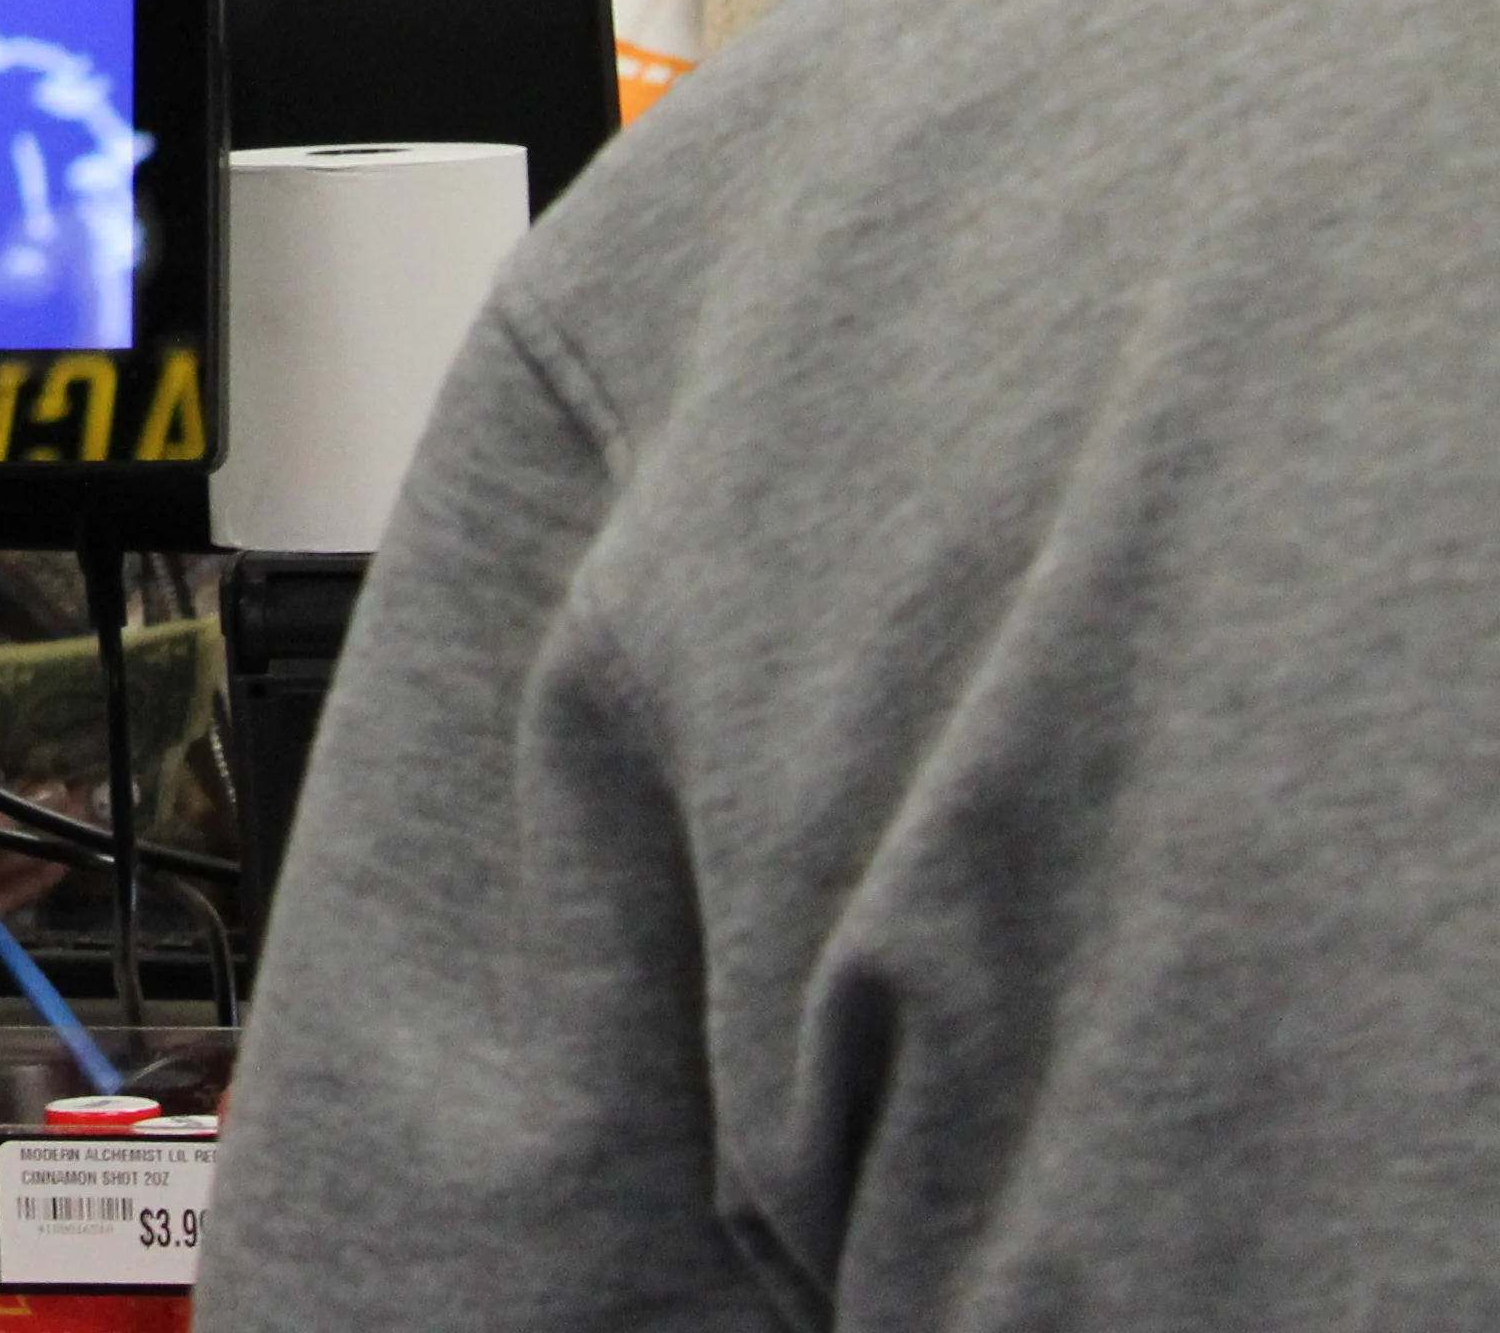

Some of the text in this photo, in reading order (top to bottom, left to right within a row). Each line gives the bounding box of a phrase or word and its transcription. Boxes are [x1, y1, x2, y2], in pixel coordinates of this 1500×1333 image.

[21, 1148, 80, 1163] MODERN
[85, 1148, 163, 1163] ALCHEMIST
[21, 1171, 97, 1186] CINNAMON
[102, 1171, 140, 1186] SHOT
[140, 1207, 206, 1249] $3.9
